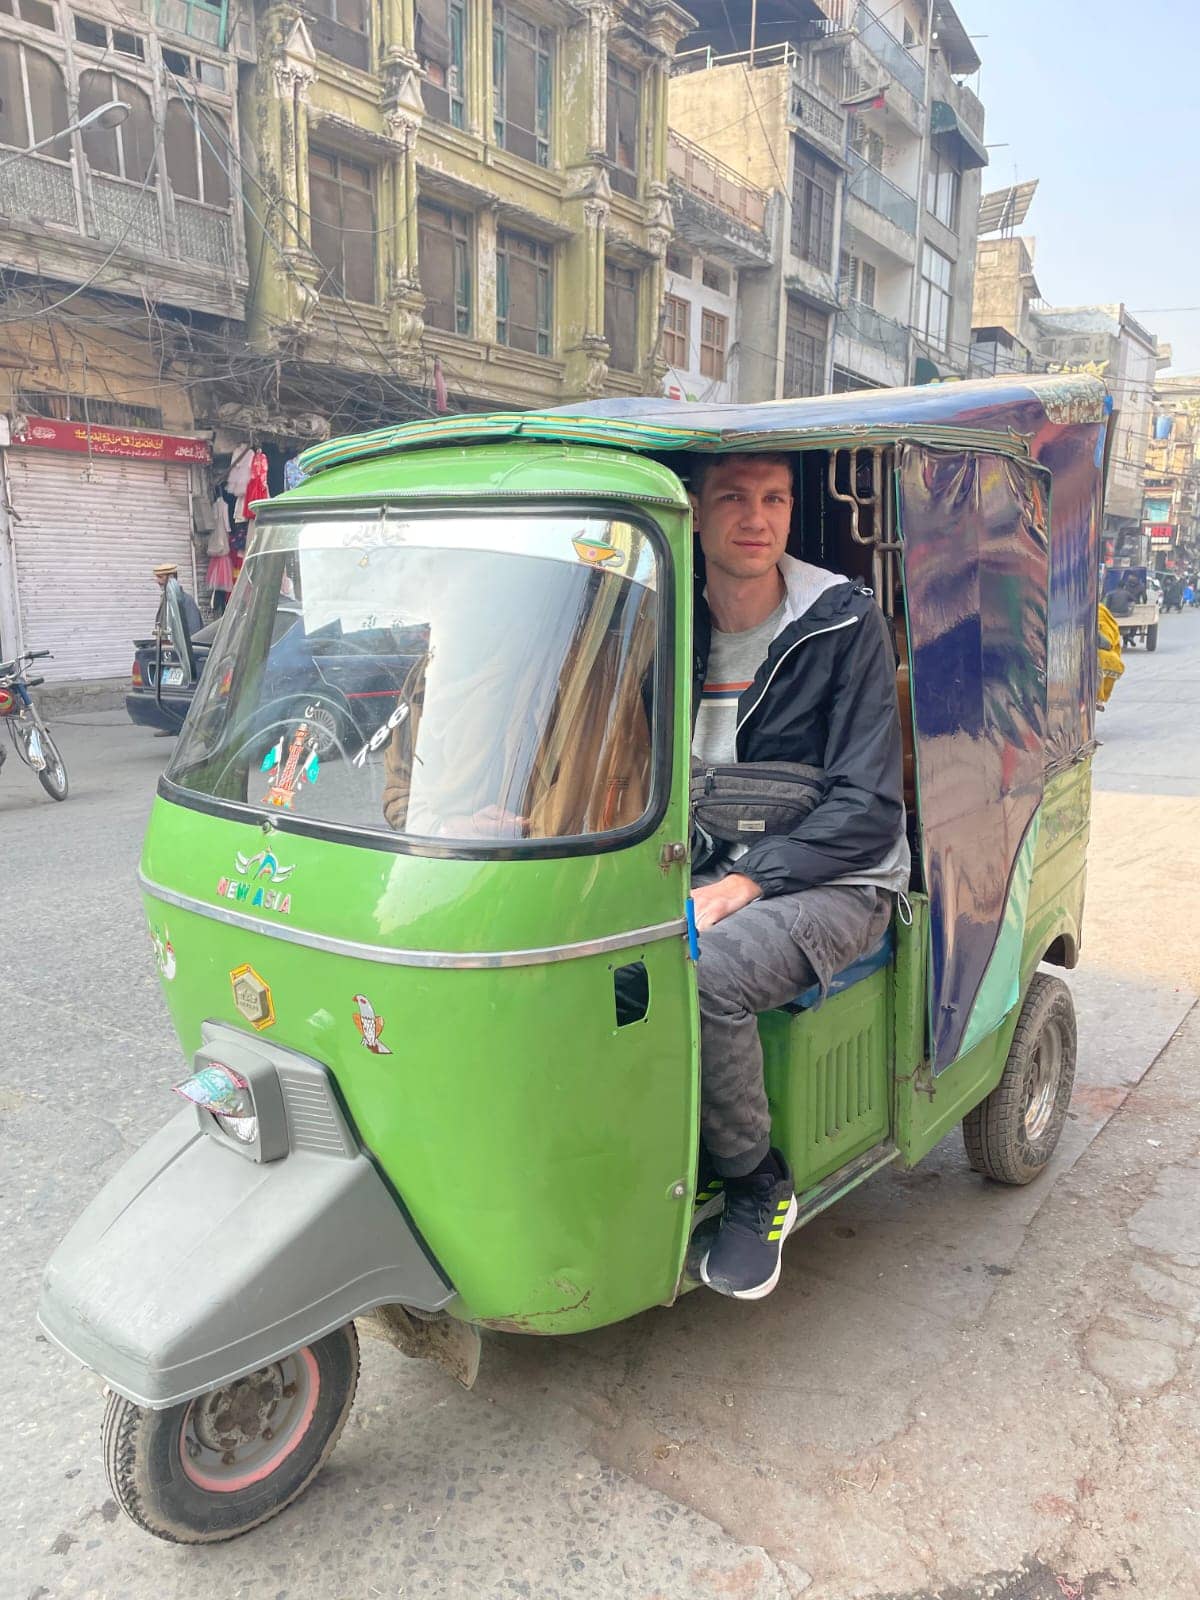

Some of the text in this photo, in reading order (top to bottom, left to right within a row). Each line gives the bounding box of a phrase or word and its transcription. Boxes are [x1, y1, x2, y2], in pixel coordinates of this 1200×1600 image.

[352, 701, 409, 769] 786
[216, 876, 292, 915] NEW ASIA
